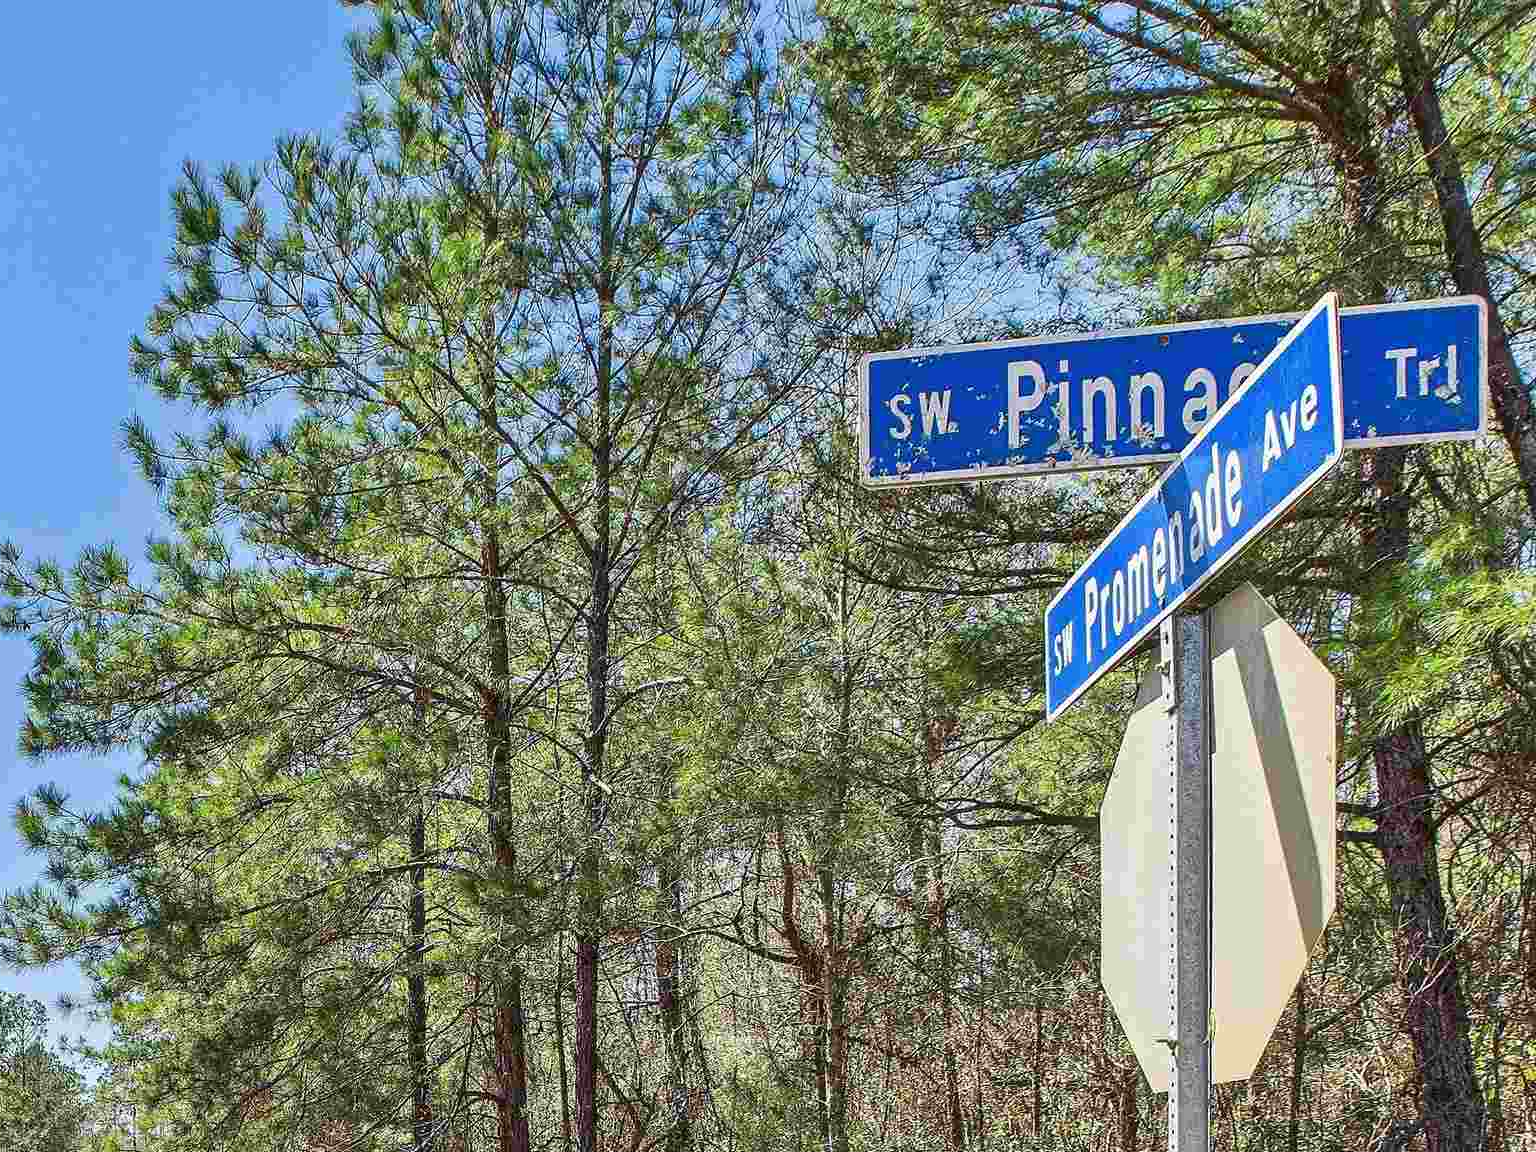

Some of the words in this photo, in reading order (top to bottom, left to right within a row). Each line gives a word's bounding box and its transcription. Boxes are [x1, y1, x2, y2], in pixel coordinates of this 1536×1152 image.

[1385, 345, 1457, 400] Trl
[1055, 621, 1073, 676] SW
[1085, 441, 1243, 665] Promenade
[1263, 384, 1318, 473] Ave
